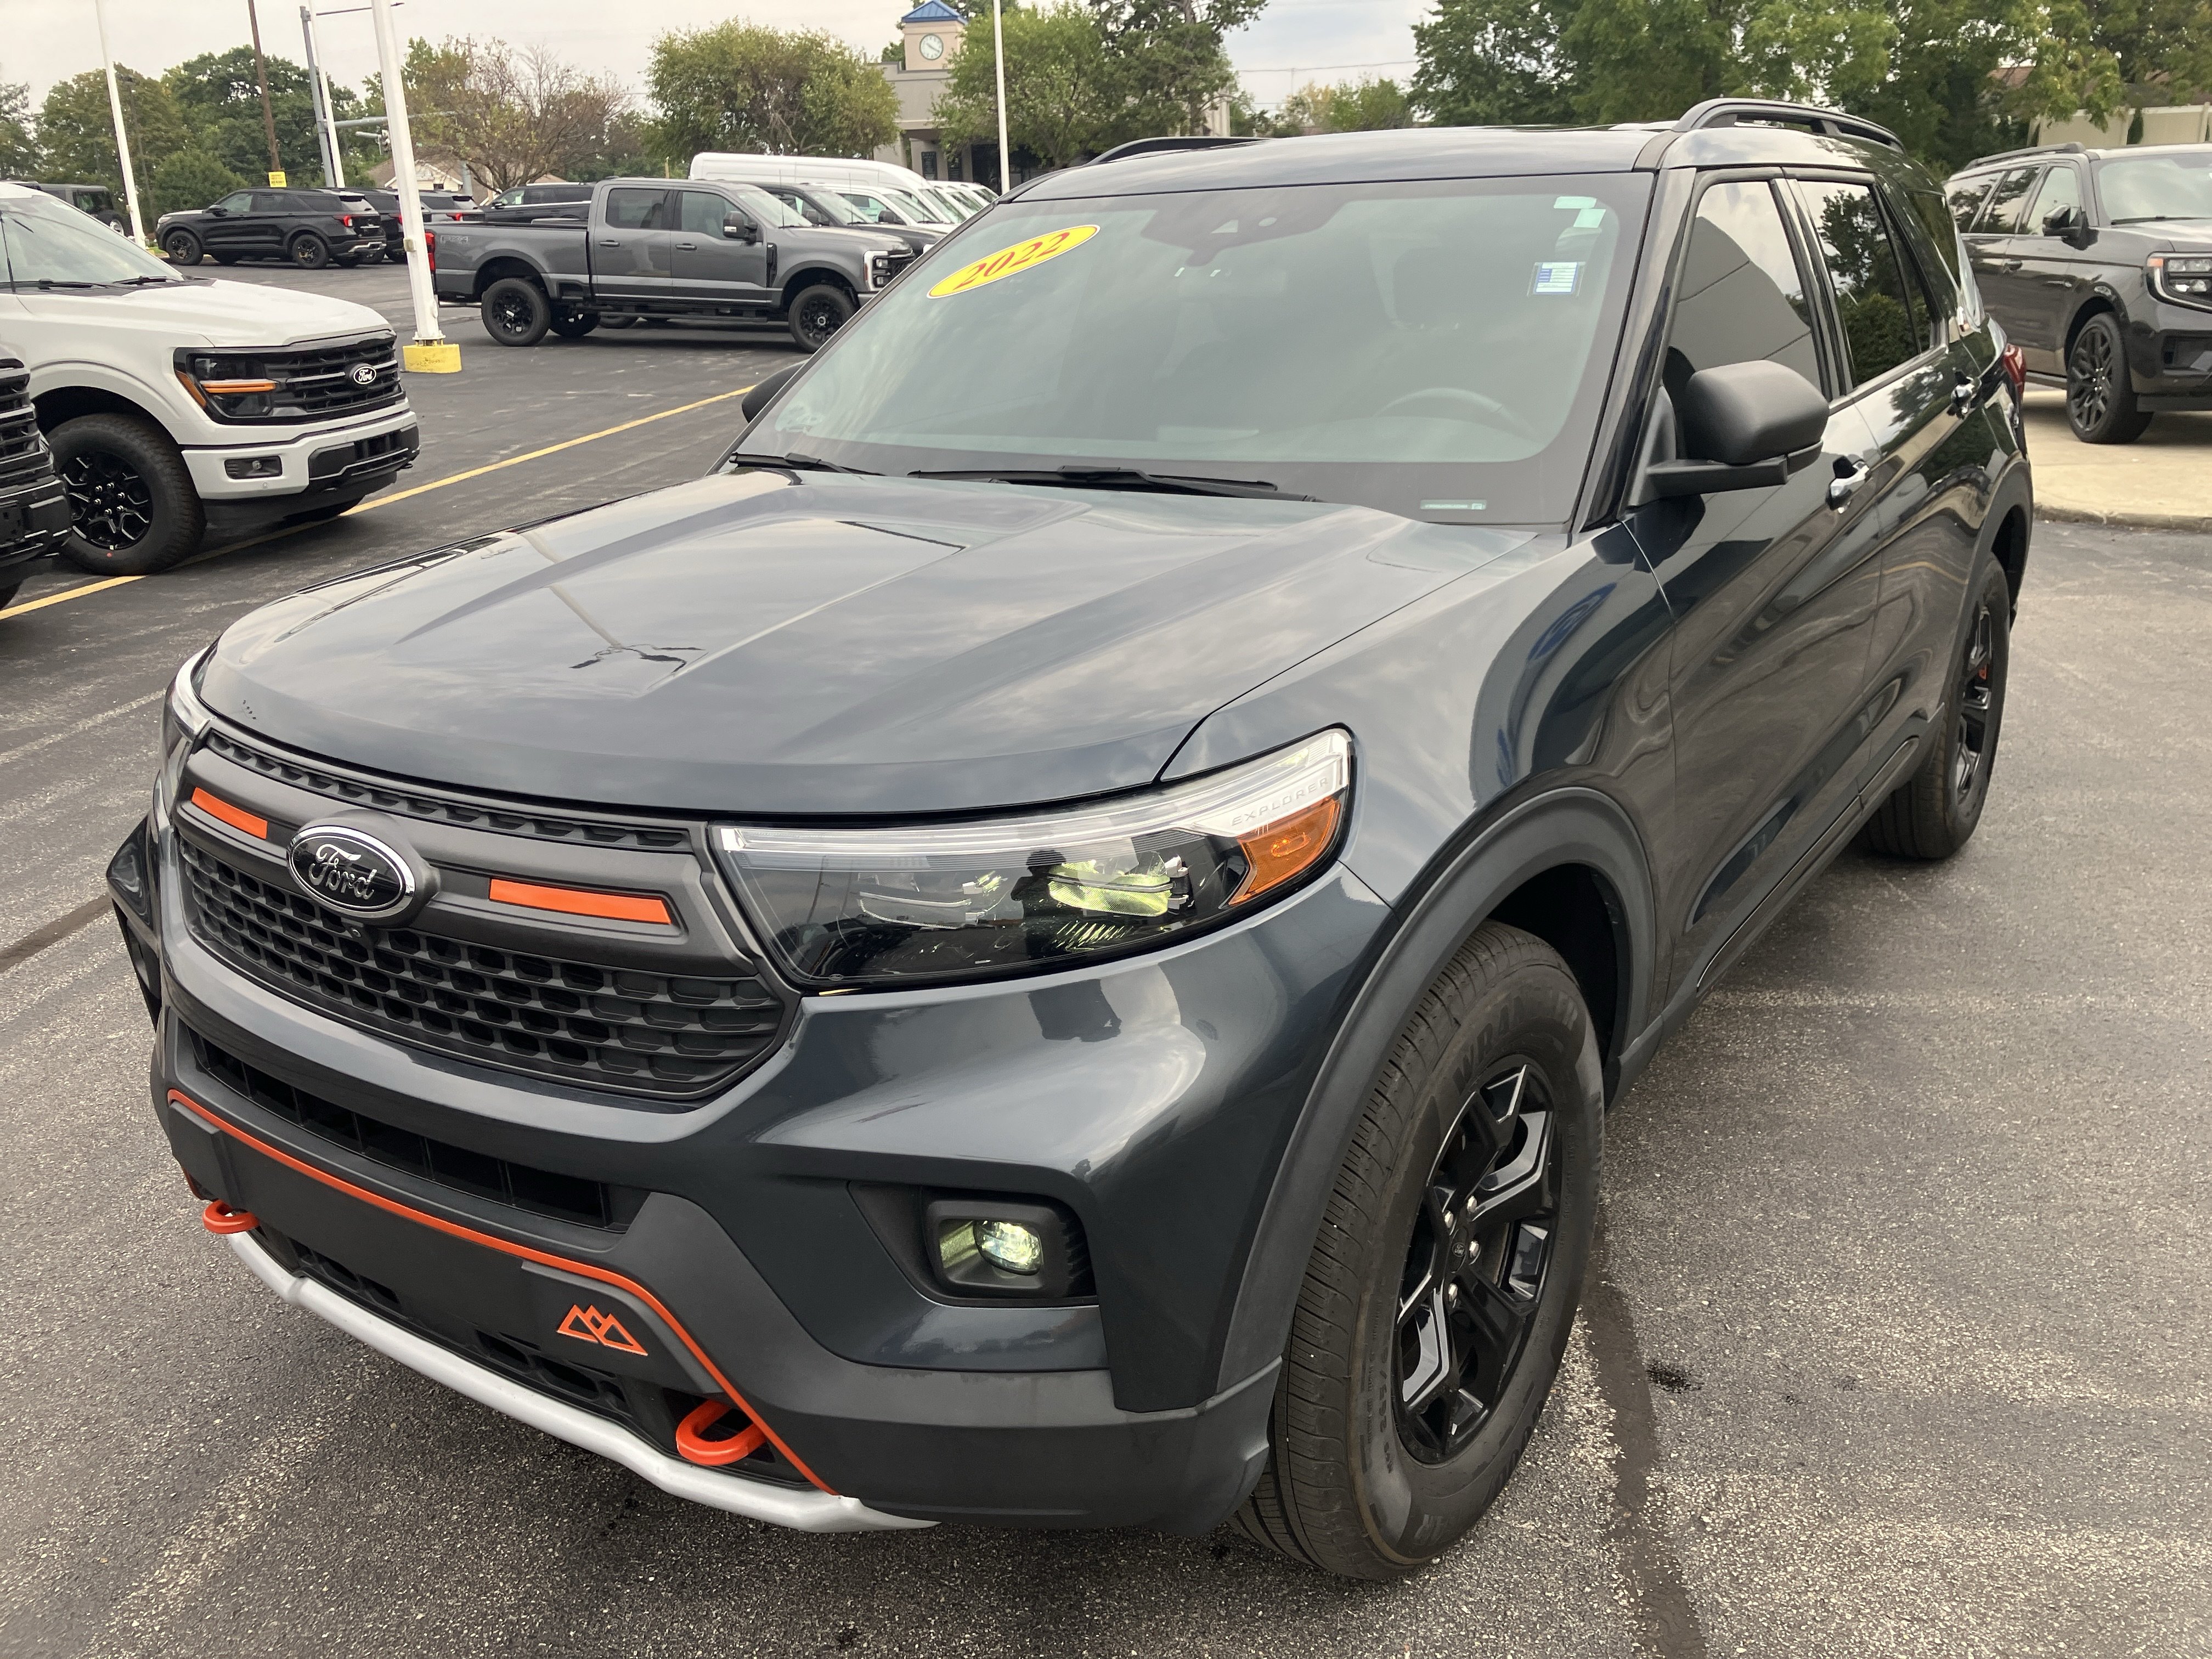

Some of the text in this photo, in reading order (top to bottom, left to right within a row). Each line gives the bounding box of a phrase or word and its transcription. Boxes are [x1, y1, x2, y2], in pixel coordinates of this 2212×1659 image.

[952, 232, 1070, 291] 2022
[358, 369, 373, 382] Ford
[1231, 776, 1329, 827] EXPLORER
[308, 843, 378, 900] Ford
[1452, 989, 1578, 1096] WRANER
[1454, 1244, 1465, 1255] Ford
